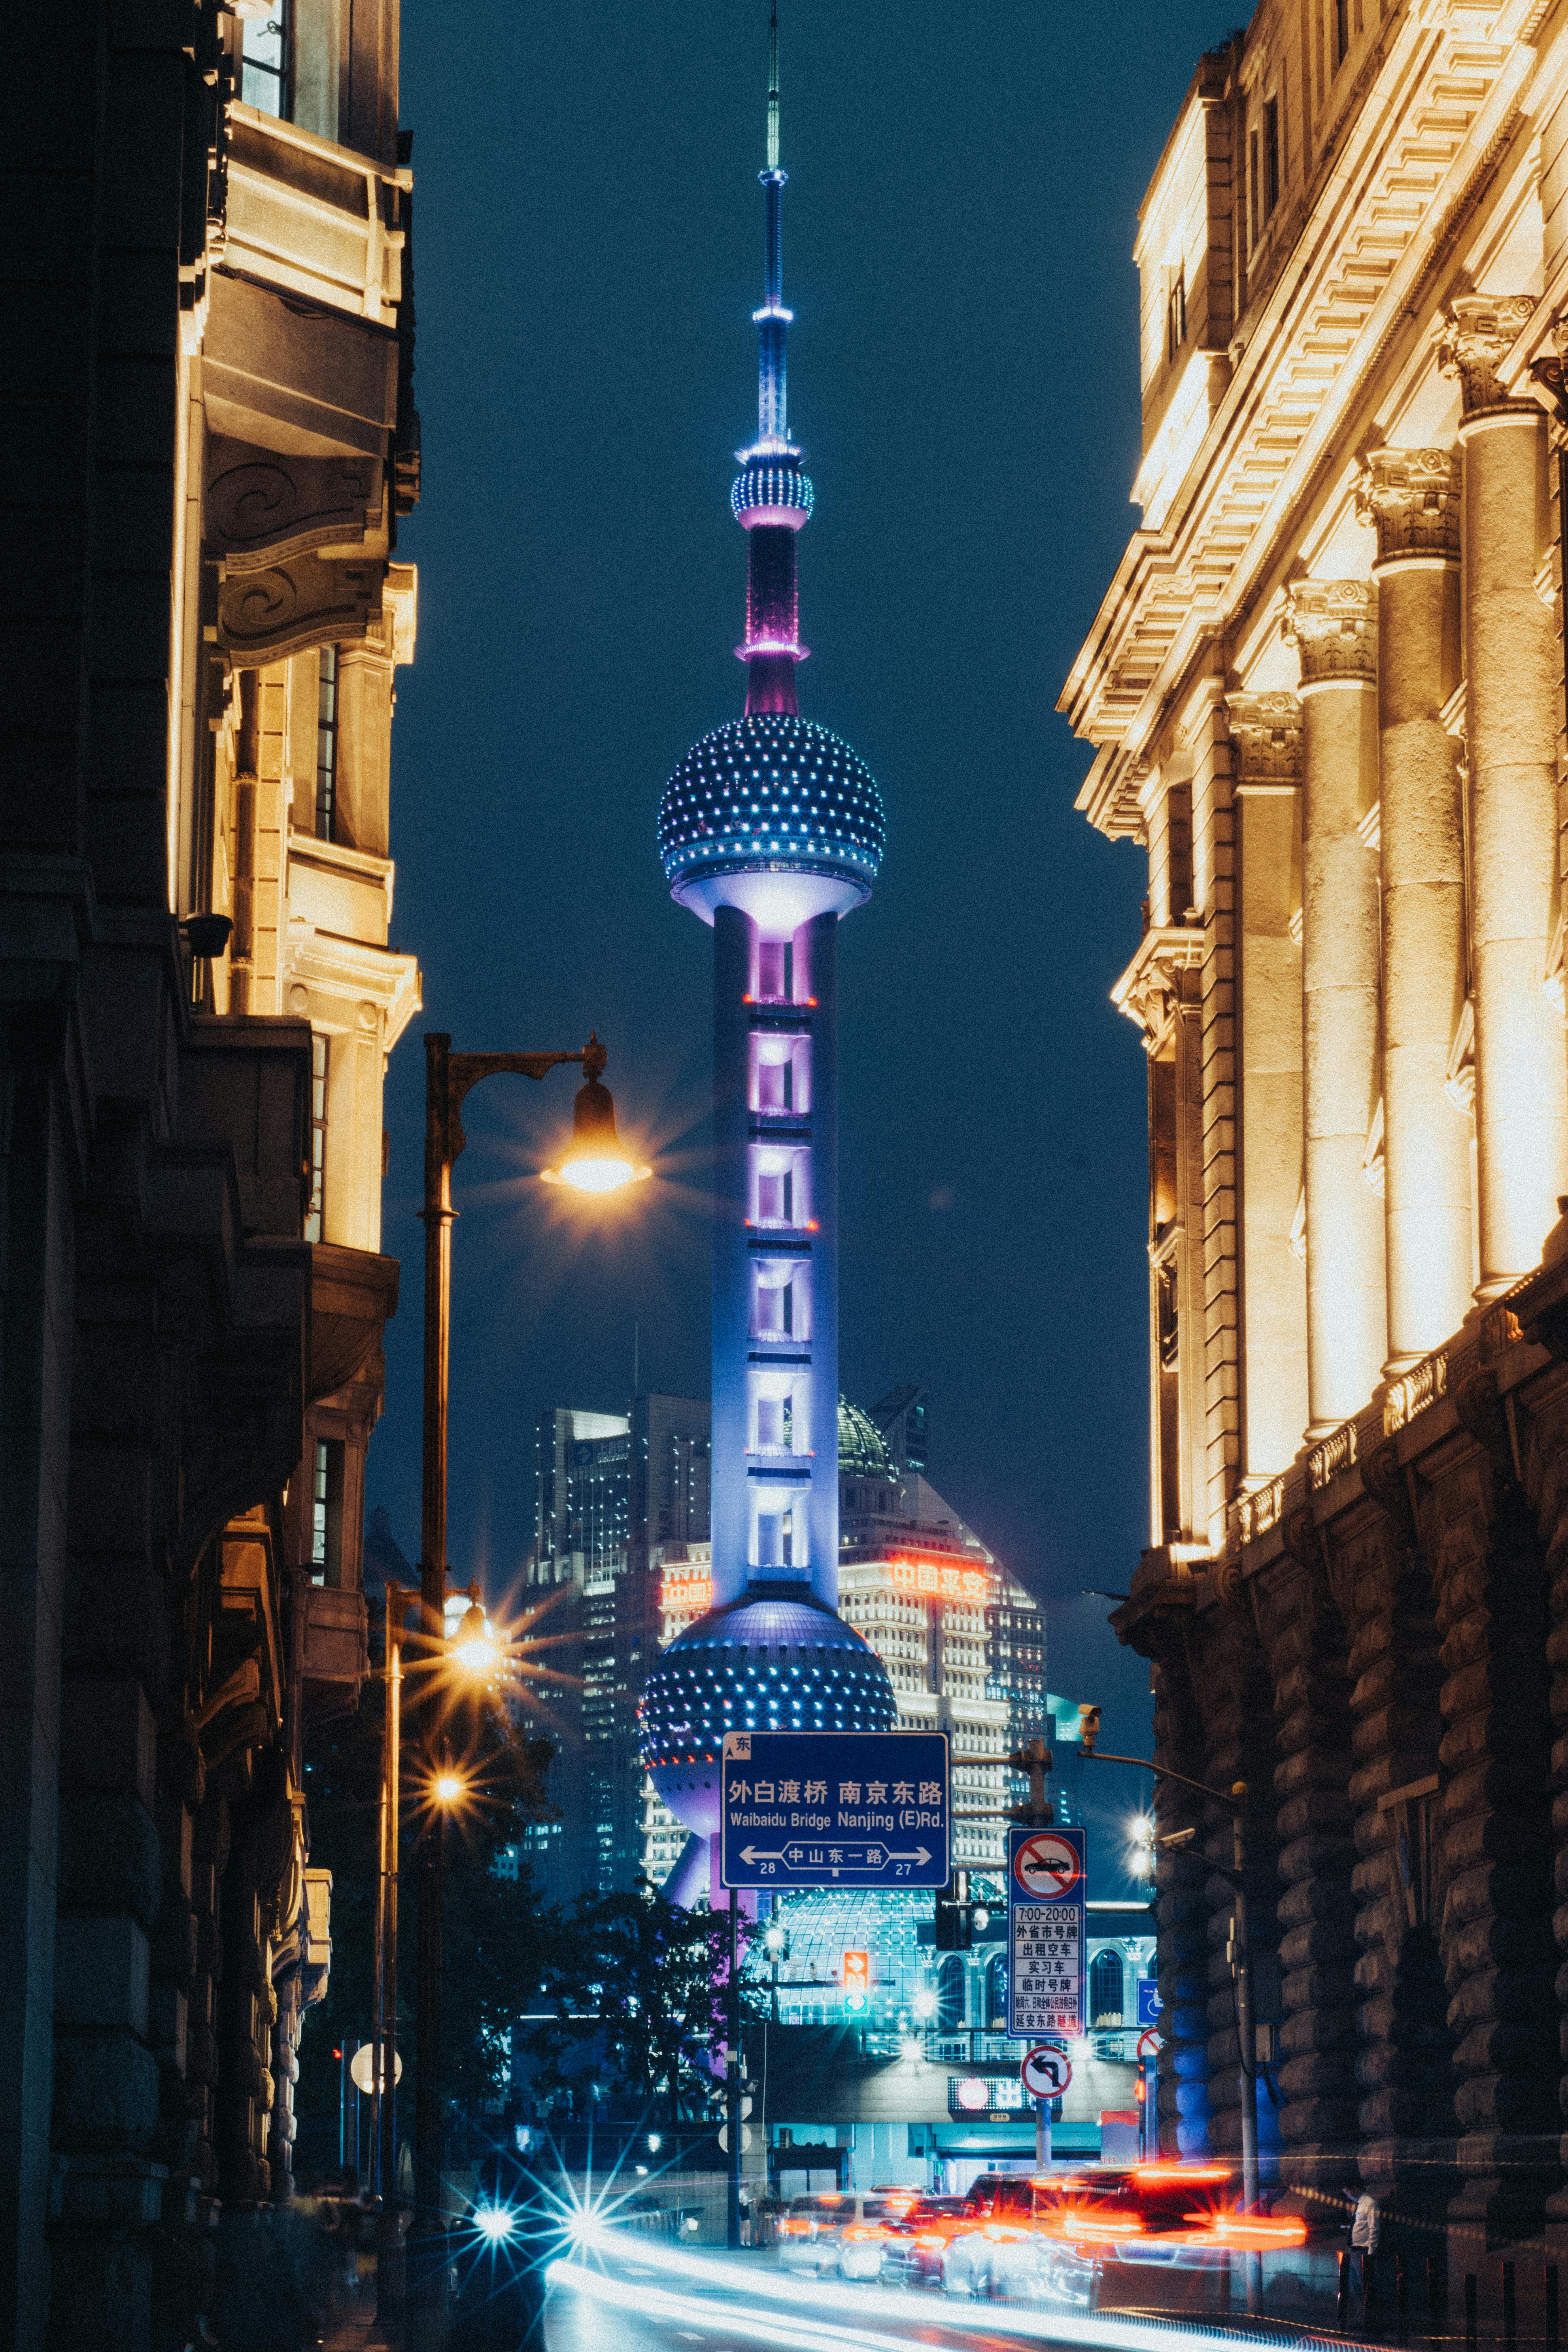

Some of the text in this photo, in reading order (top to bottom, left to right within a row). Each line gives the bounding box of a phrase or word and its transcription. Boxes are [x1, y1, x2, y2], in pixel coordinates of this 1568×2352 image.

[895, 1561, 988, 1598] 中国平安
[736, 1737, 750, 1751] 东
[728, 1780, 943, 1805] 外白渡桥 南京东路
[731, 1812, 786, 1827] Waibaidu
[791, 1813, 831, 1831] Bridge
[838, 1812, 894, 1831] Nanjing
[789, 1848, 882, 1864] 中山东一路
[760, 1863, 776, 1874] 28
[895, 1864, 911, 1876] 27
[1019, 1908, 1075, 1921] 7:00-20:00
[1016, 1925, 1077, 1939] 外省市号牌
[1023, 1944, 1071, 1957] 出租空车
[1029, 1961, 1065, 1974] 实习车
[1022, 1978, 1071, 1992] 临时号牌
[1016, 2014, 1077, 2028] 延安东路隧道
